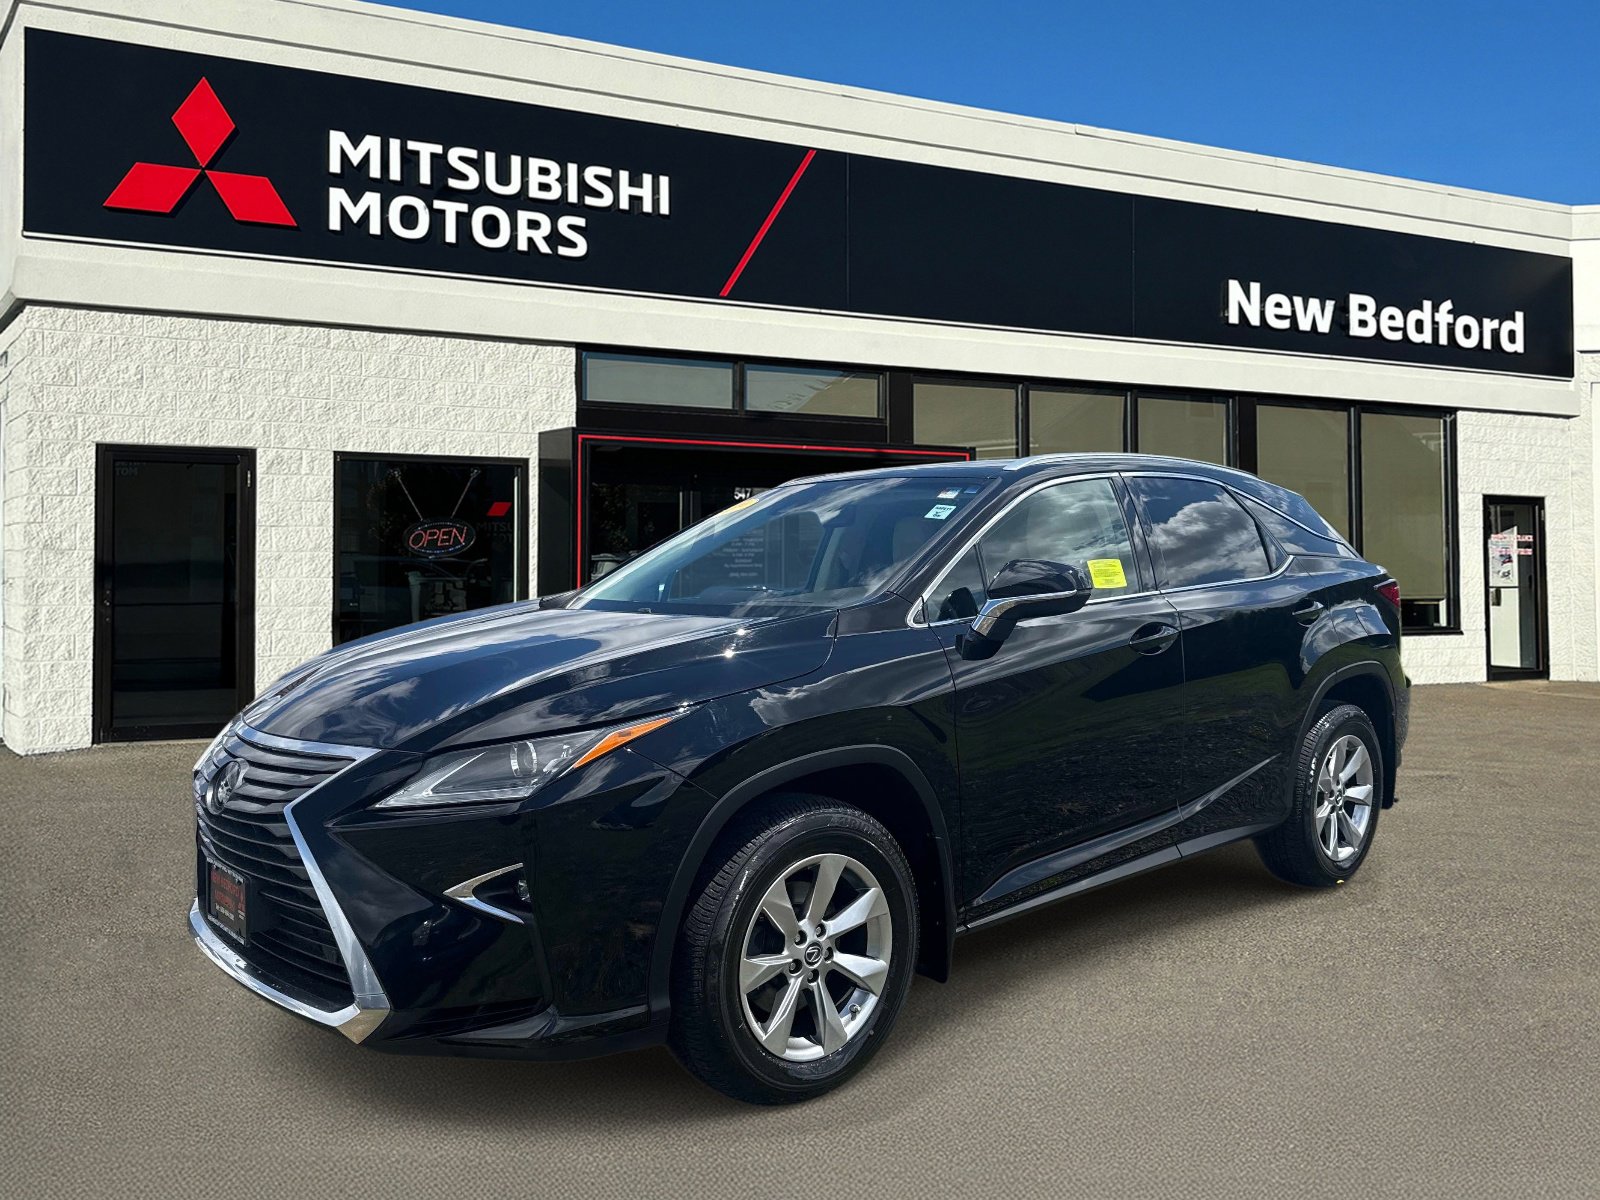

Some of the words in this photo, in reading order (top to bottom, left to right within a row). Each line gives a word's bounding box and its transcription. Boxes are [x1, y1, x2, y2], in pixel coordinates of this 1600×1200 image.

[329, 130, 670, 215] MITSUBISHI
[329, 187, 588, 258] MOTORS
[1228, 279, 1336, 334] New
[1349, 293, 1525, 353] Bedford
[734, 487, 751, 500] 547
[408, 526, 467, 549] OPEN
